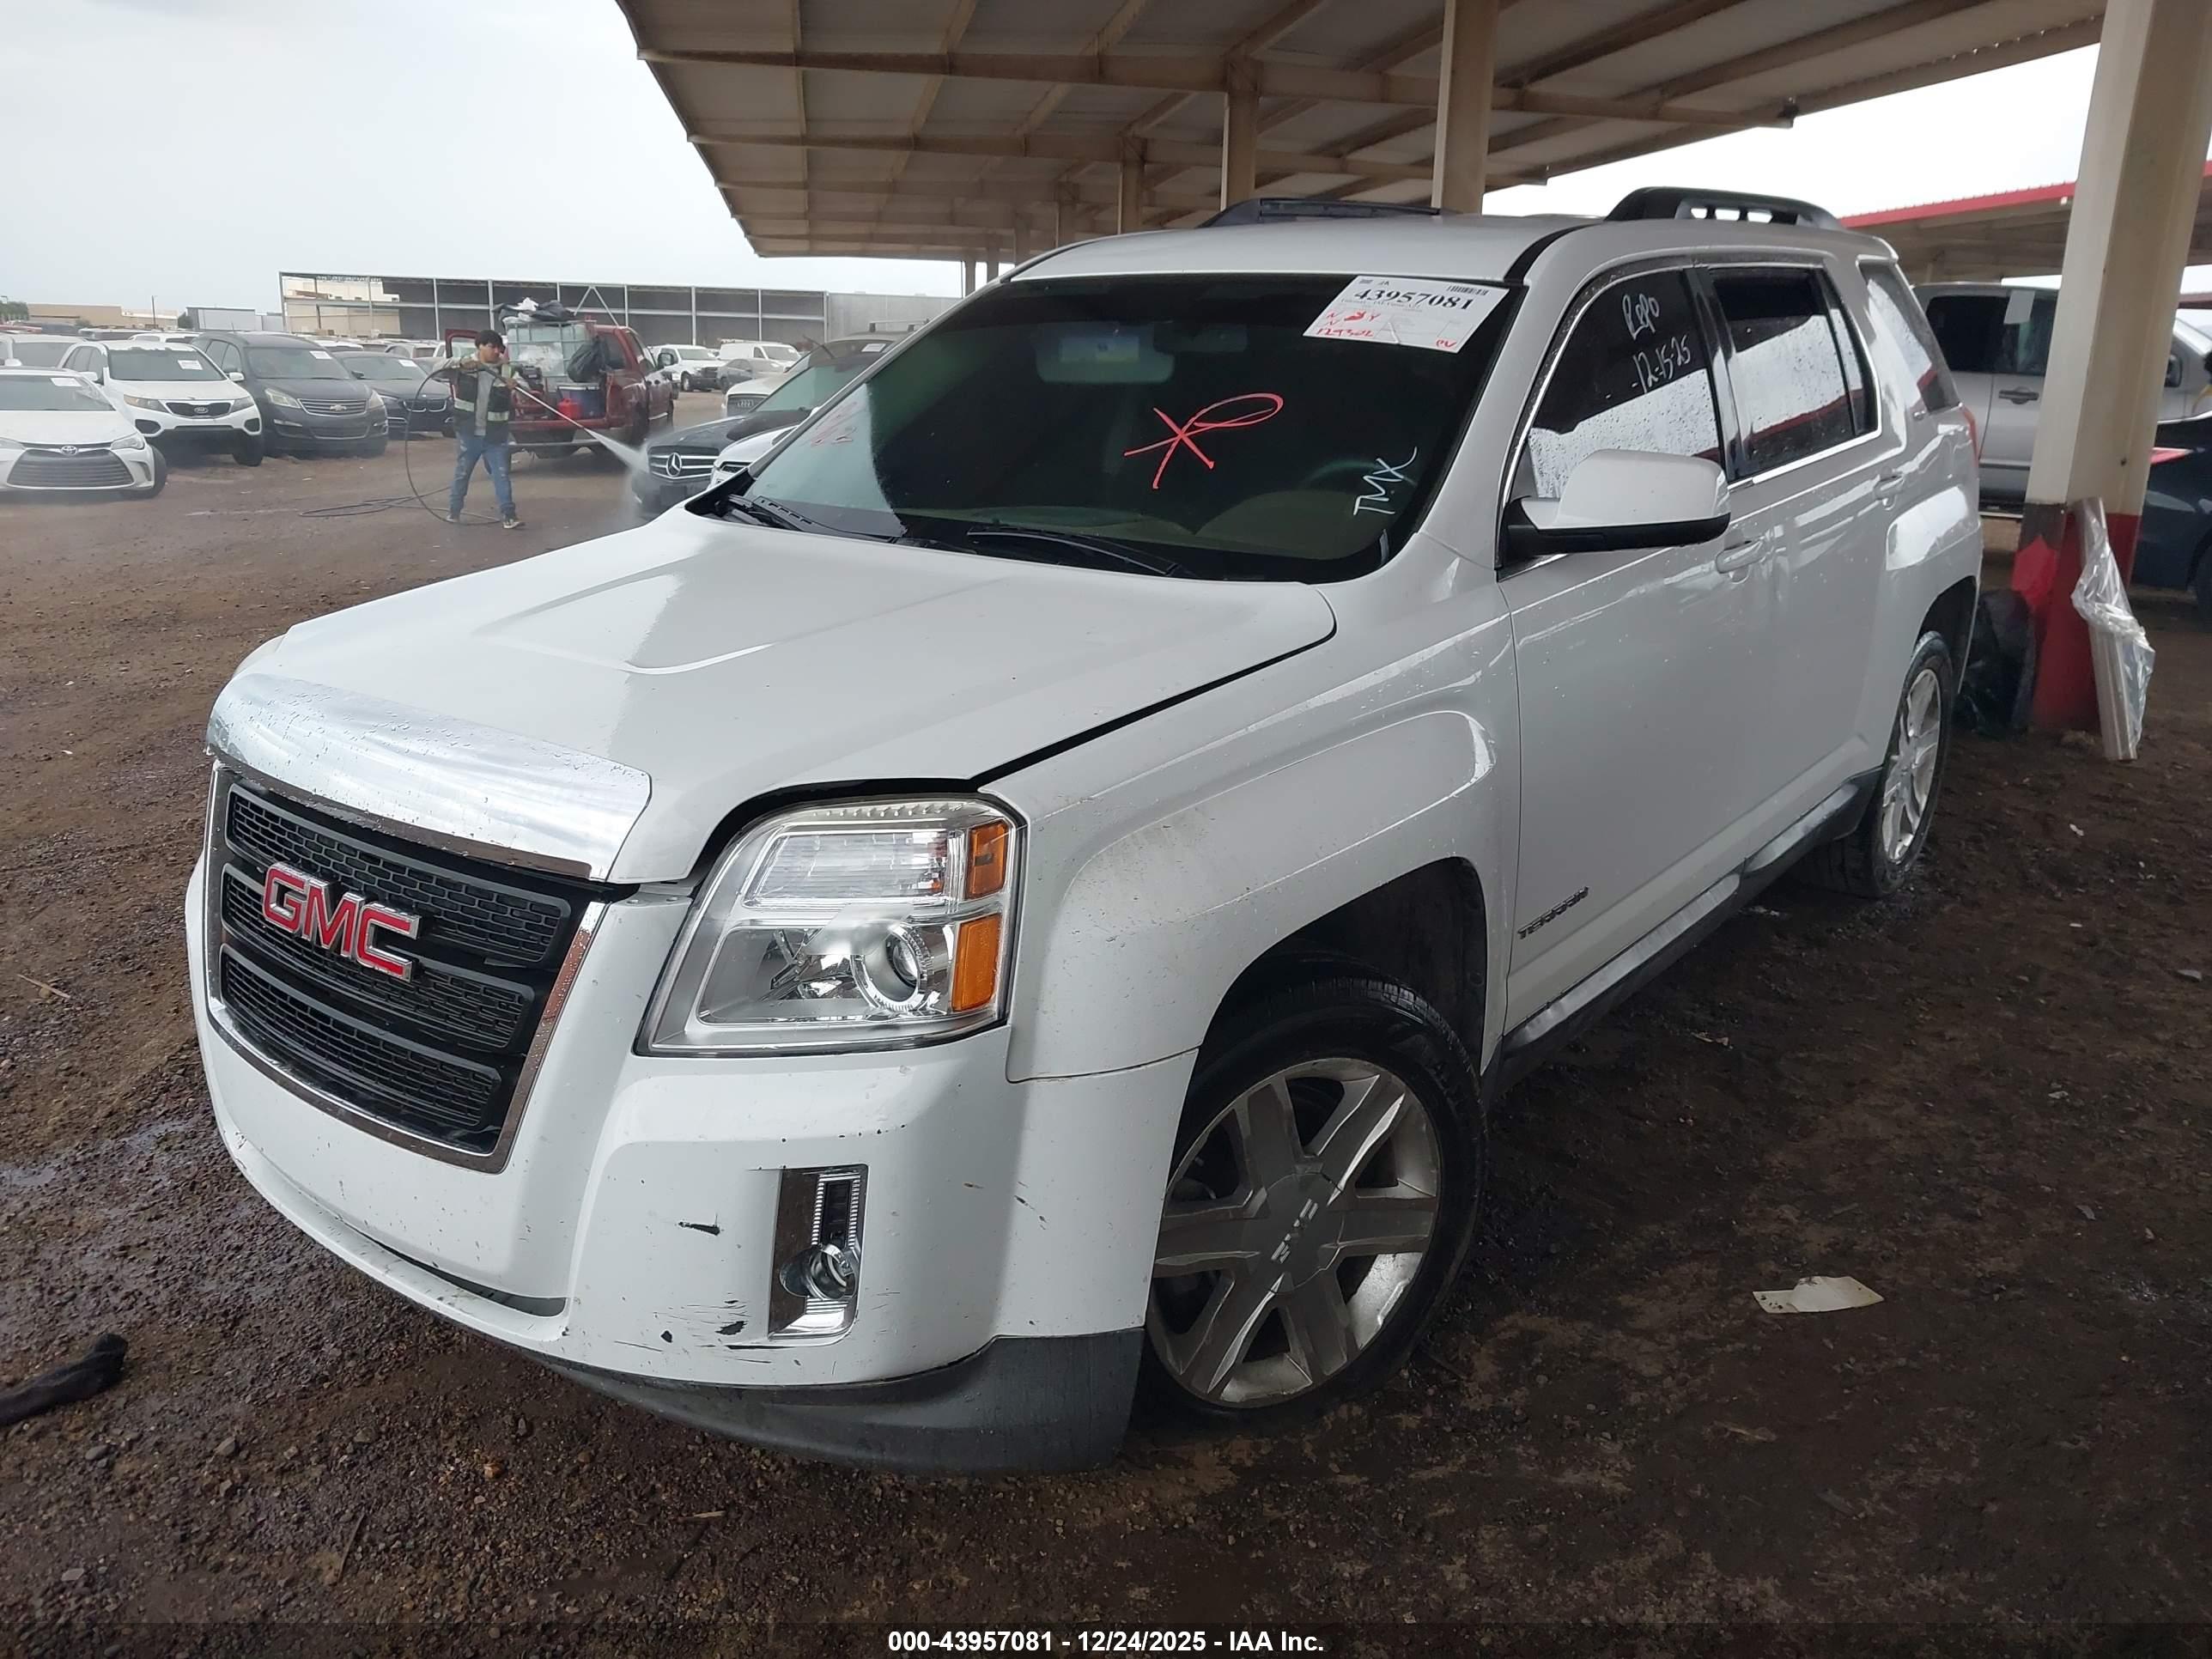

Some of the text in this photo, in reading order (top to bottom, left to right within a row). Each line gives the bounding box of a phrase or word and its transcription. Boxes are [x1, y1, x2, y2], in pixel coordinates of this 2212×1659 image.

[1354, 289, 1474, 311] 43957081
[1352, 446, 1418, 516] TMX
[262, 861, 422, 983] GMC
